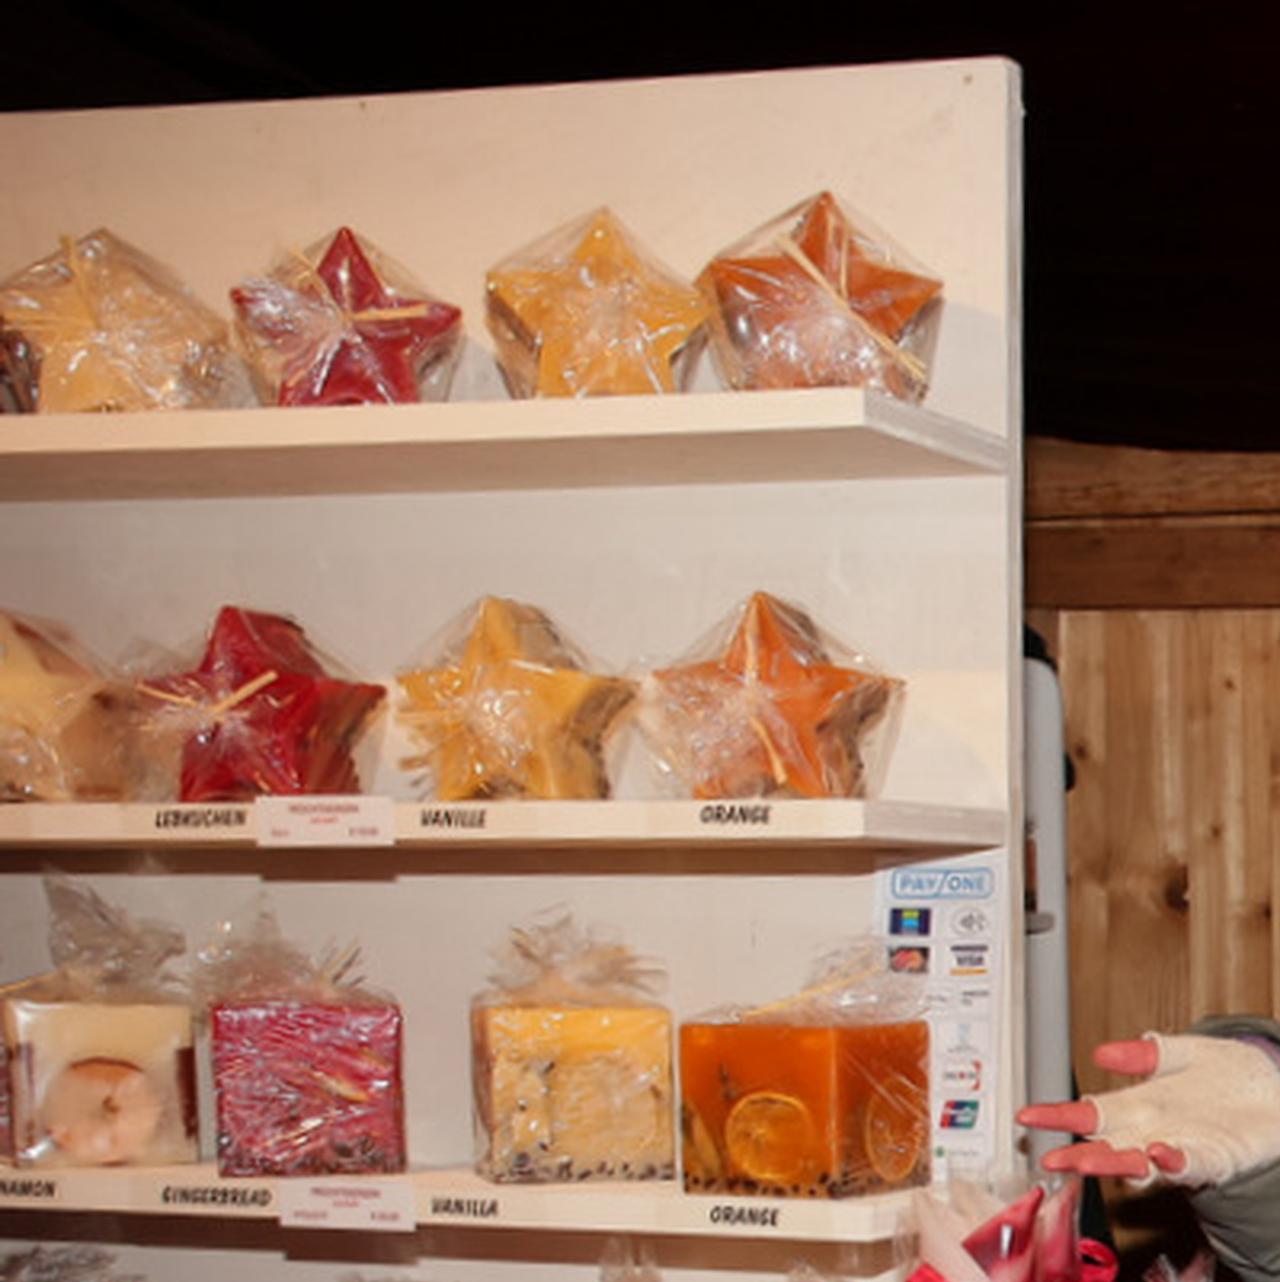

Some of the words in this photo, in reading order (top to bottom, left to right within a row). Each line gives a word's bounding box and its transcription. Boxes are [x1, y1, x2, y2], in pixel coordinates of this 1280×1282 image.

[156, 809, 247, 828] LEBKUCHEN
[420, 809, 486, 828] VANILLE
[699, 806, 771, 825] ORANGE
[161, 1186, 273, 1207] GINGERBREAD
[430, 1200, 499, 1216] VANILLA
[709, 1206, 780, 1227] ORANGE
